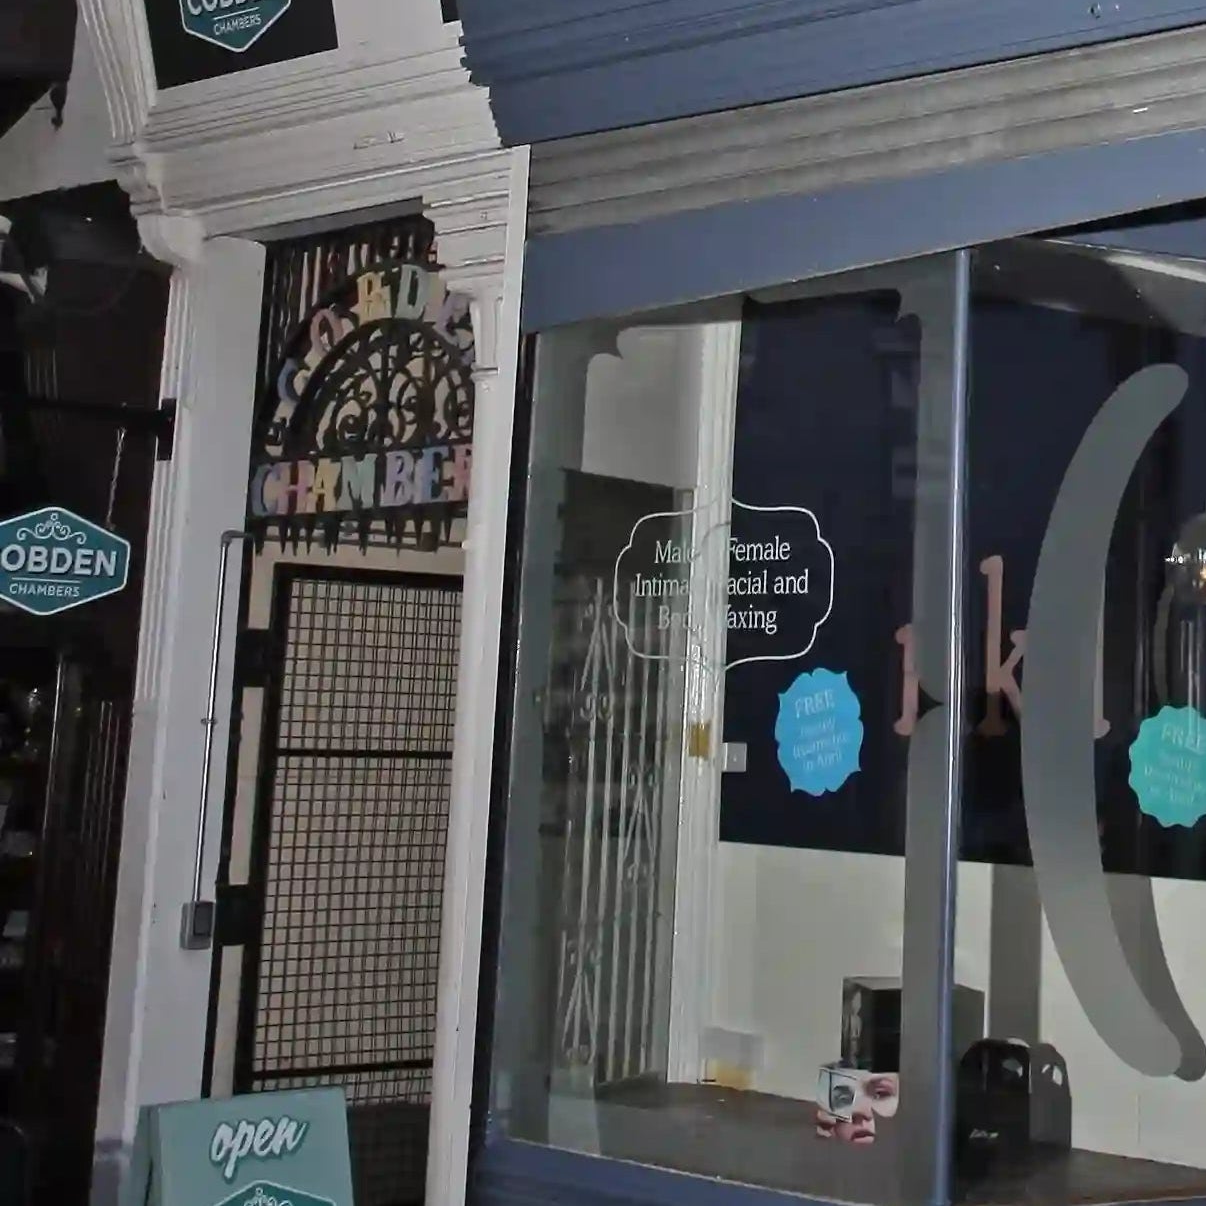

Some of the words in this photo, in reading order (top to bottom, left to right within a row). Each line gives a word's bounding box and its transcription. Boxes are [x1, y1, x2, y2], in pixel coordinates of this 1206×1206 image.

[213, 13, 262, 36] CHAMBERS
[9, 582, 81, 598] CHAMBERS
[773, 568, 809, 595] and
[209, 1115, 308, 1180] open
